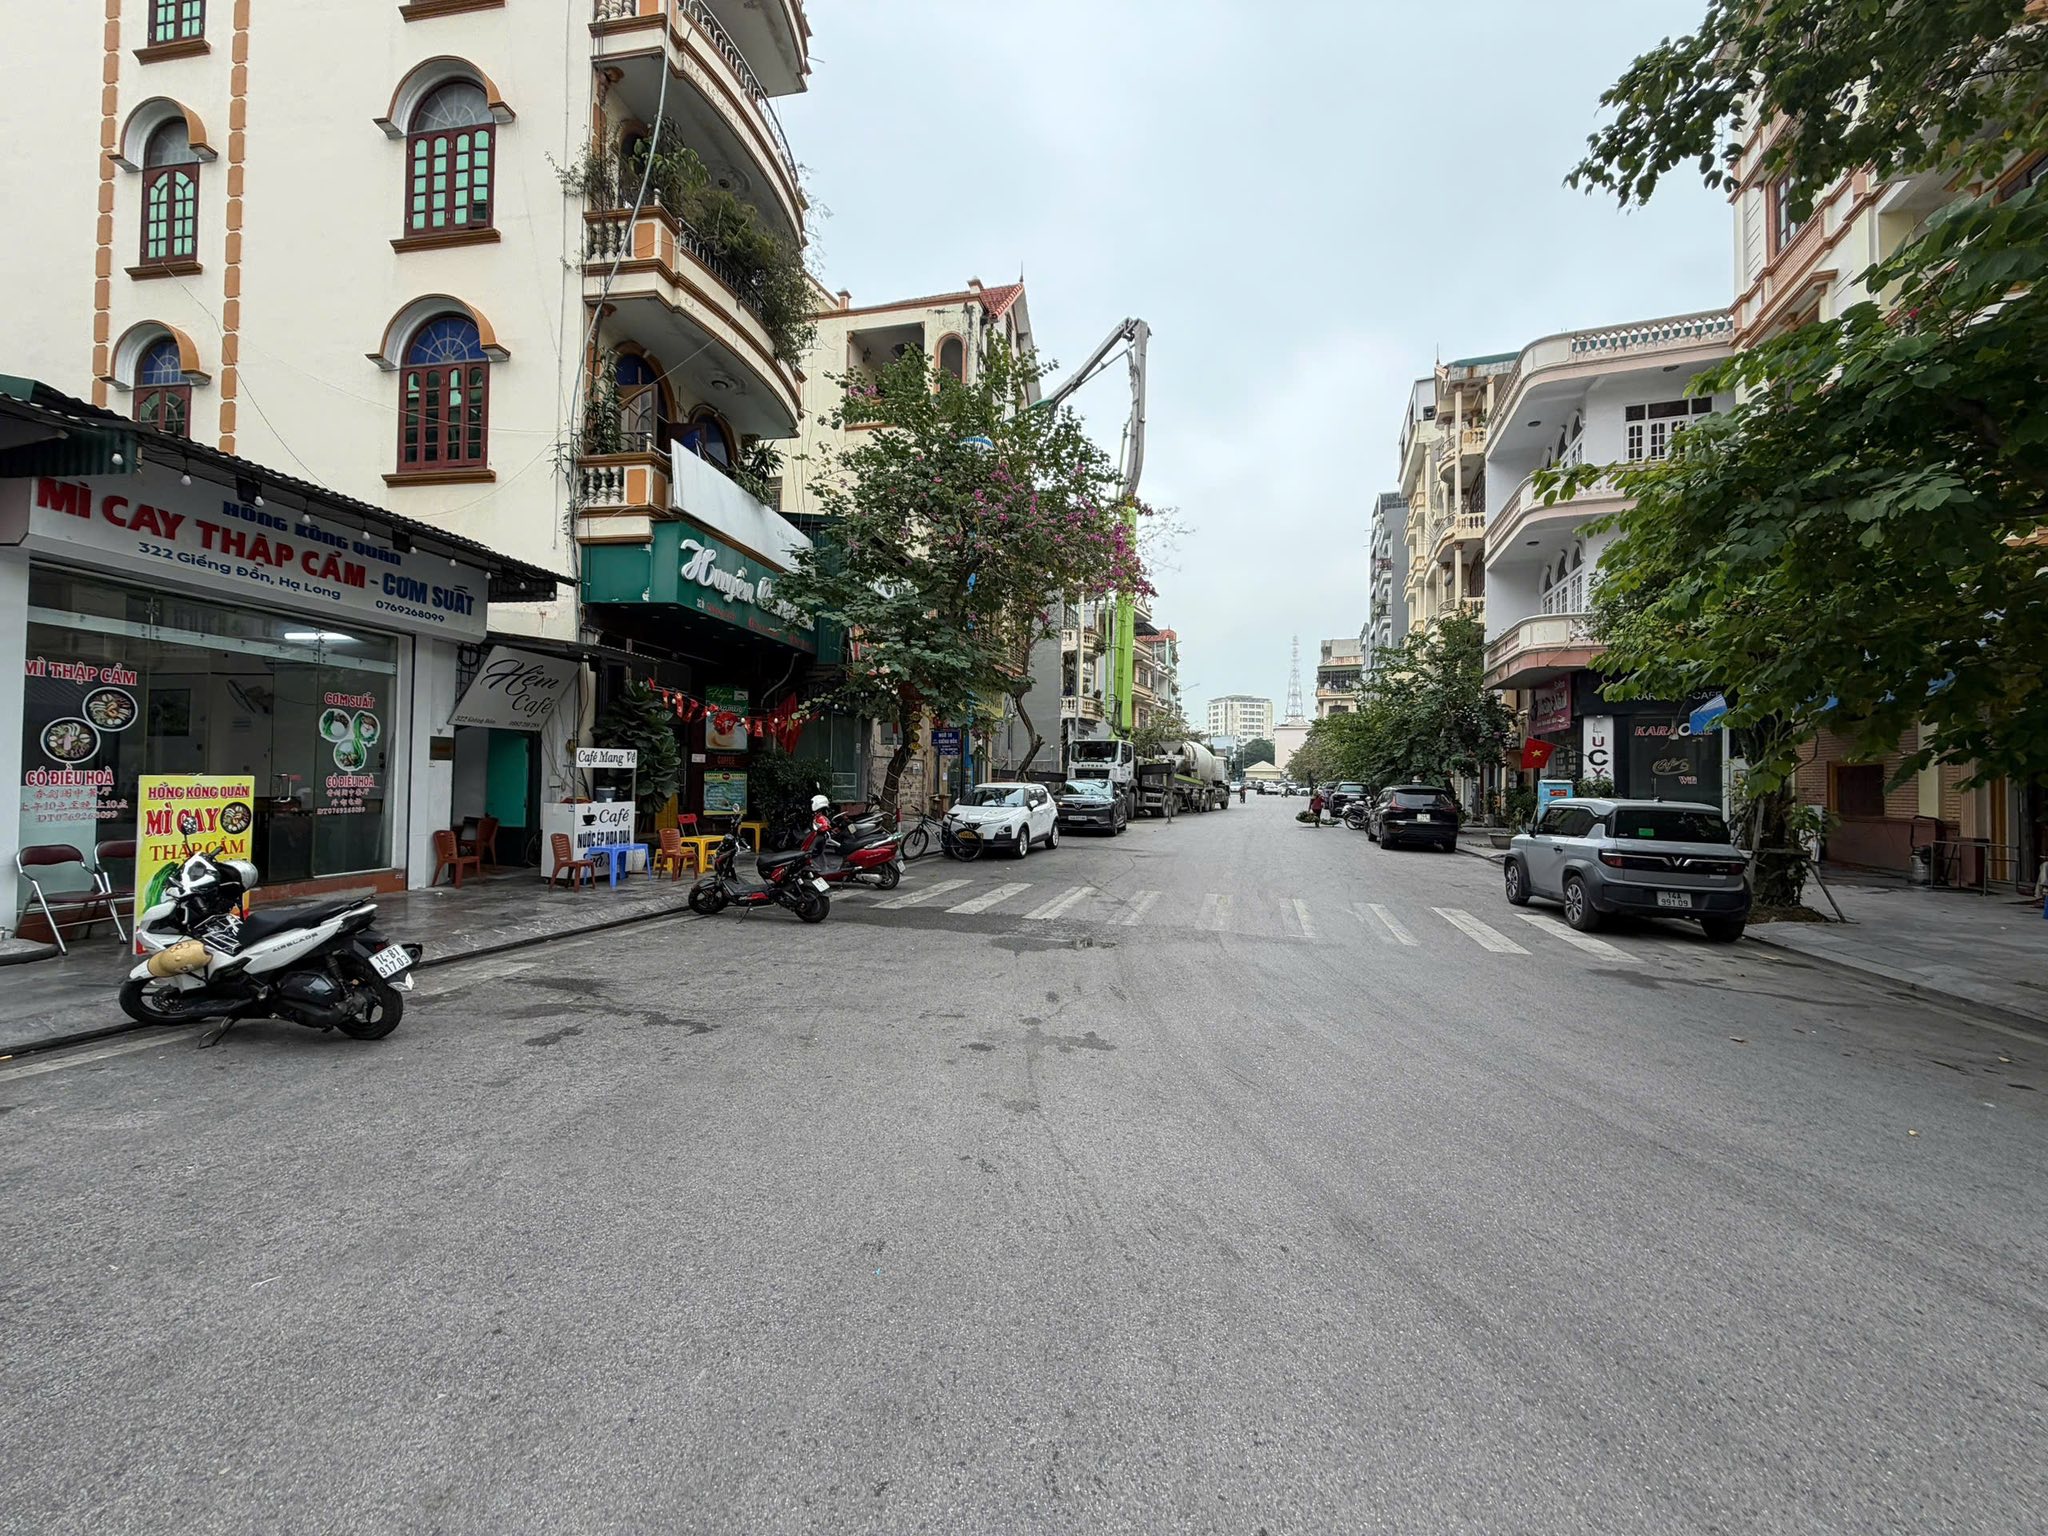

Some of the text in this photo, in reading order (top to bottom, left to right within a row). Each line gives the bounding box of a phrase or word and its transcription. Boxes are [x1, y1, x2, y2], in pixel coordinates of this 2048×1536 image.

[37, 477, 93, 519] MÌ
[102, 495, 186, 541] CAY
[195, 518, 295, 568] THẬP
[382, 572, 429, 604] CƠM
[432, 584, 475, 616] SUẤT
[138, 542, 341, 600] 322 Giếng Đồn, Hạ Long
[375, 600, 446, 623] 0769268099
[25, 656, 46, 677] MÌ
[49, 661, 99, 685] THẬP
[511, 694, 556, 718] Café
[577, 750, 598, 766] Café
[599, 750, 625, 767] Mang
[26, 765, 47, 787] CÓ
[48, 762, 83, 787] ĐIỀU
[148, 782, 251, 800] HỒNG KÔNG QUÁN
[145, 801, 174, 837] MÌ
[599, 808, 631, 826] Café
[605, 830, 618, 846] HOA
[375, 947, 400, 966] 14-B1
